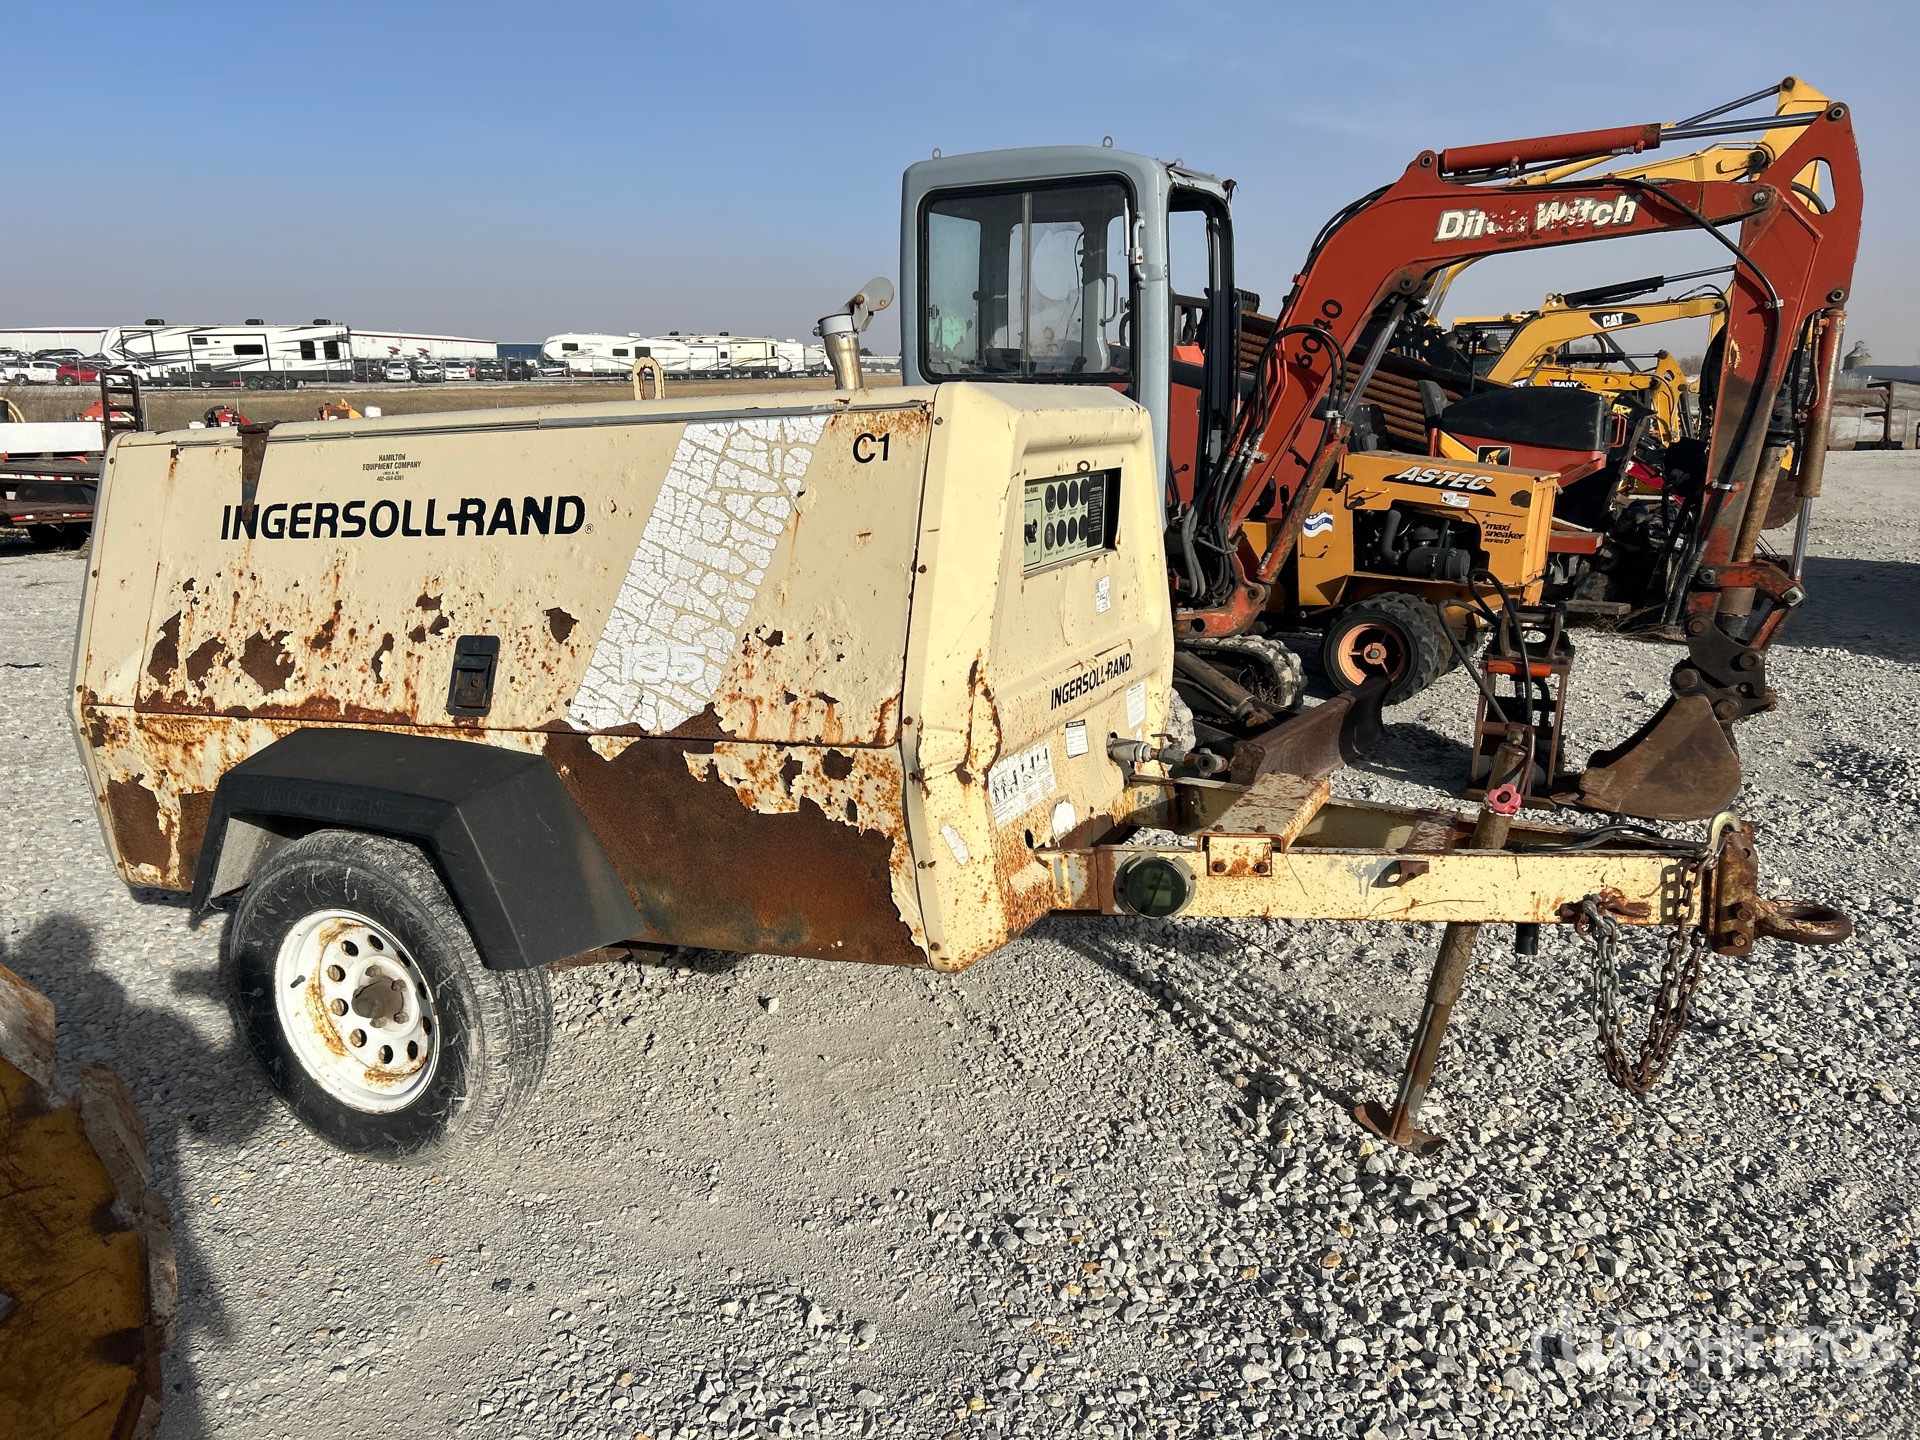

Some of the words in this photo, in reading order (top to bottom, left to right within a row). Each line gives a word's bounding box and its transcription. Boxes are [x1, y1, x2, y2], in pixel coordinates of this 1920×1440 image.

[1602, 312, 1624, 328] CAT
[1553, 380, 1580, 388] SANY
[853, 432, 891, 464] C1
[378, 453, 406, 462] HAMILTON
[362, 462, 394, 471] EQUIPMENT
[394, 460, 421, 470] COMPANY
[1395, 466, 1494, 491] ASTEC
[221, 495, 586, 540] INGERSOLL-RAND
[1485, 522, 1512, 532] maxi
[1483, 529, 1526, 541] sneaker
[1050, 652, 1132, 711] INGERSOLL-RAND
